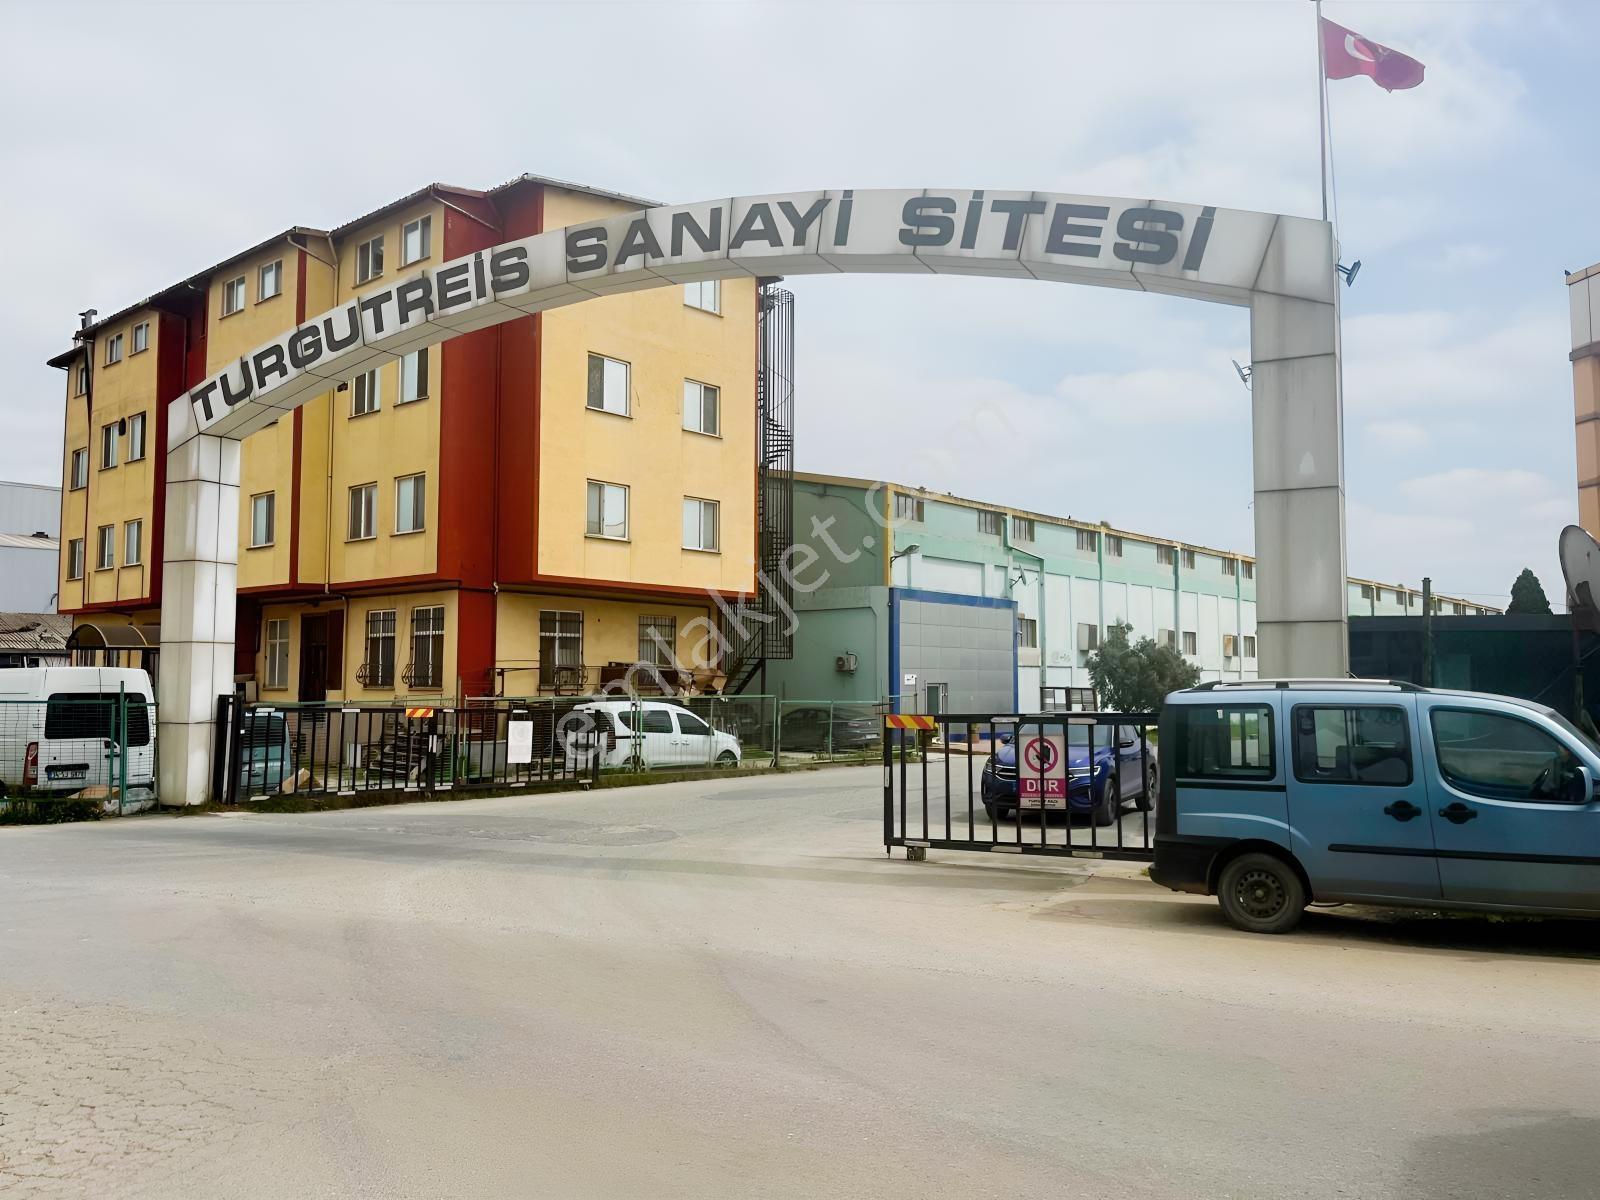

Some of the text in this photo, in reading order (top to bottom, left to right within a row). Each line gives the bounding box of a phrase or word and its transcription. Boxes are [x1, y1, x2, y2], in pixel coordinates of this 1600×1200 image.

[190, 190, 1215, 421] TURGUTREİS SANAYİ SİTESİ
